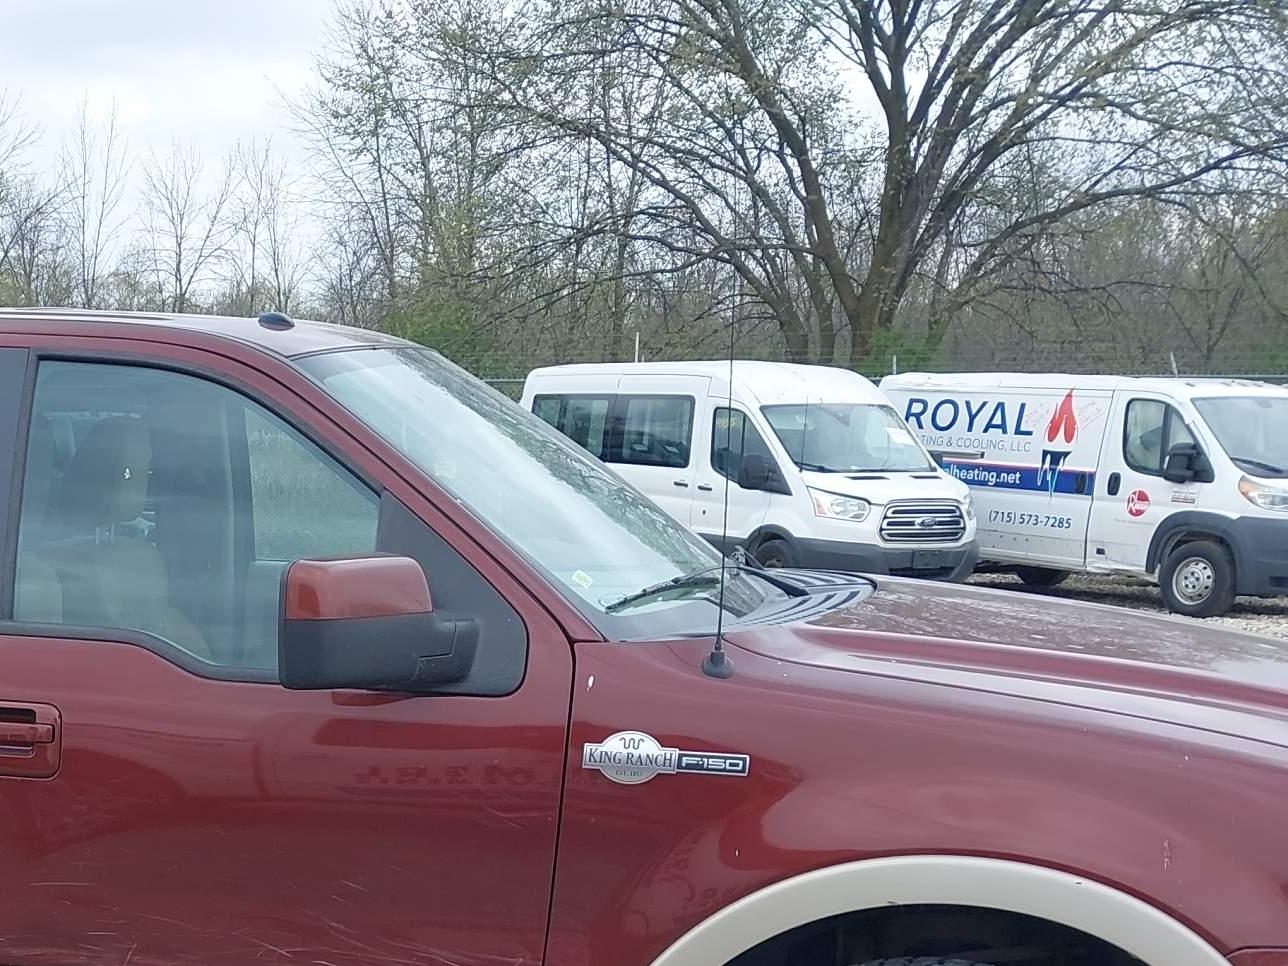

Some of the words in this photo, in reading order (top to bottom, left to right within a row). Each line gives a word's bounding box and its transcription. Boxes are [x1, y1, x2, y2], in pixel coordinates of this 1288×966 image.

[905, 398, 1033, 436] ROYAL
[916, 434, 944, 447] TING
[946, 436, 953, 447] &
[956, 437, 1007, 452] COOLING,
[1011, 440, 1032, 453] LLC
[988, 509, 1016, 526] (715)
[1018, 512, 1072, 529] 573-7285
[588, 747, 622, 765] KING
[626, 751, 673, 768] RANCH
[681, 756, 743, 770] F-150
